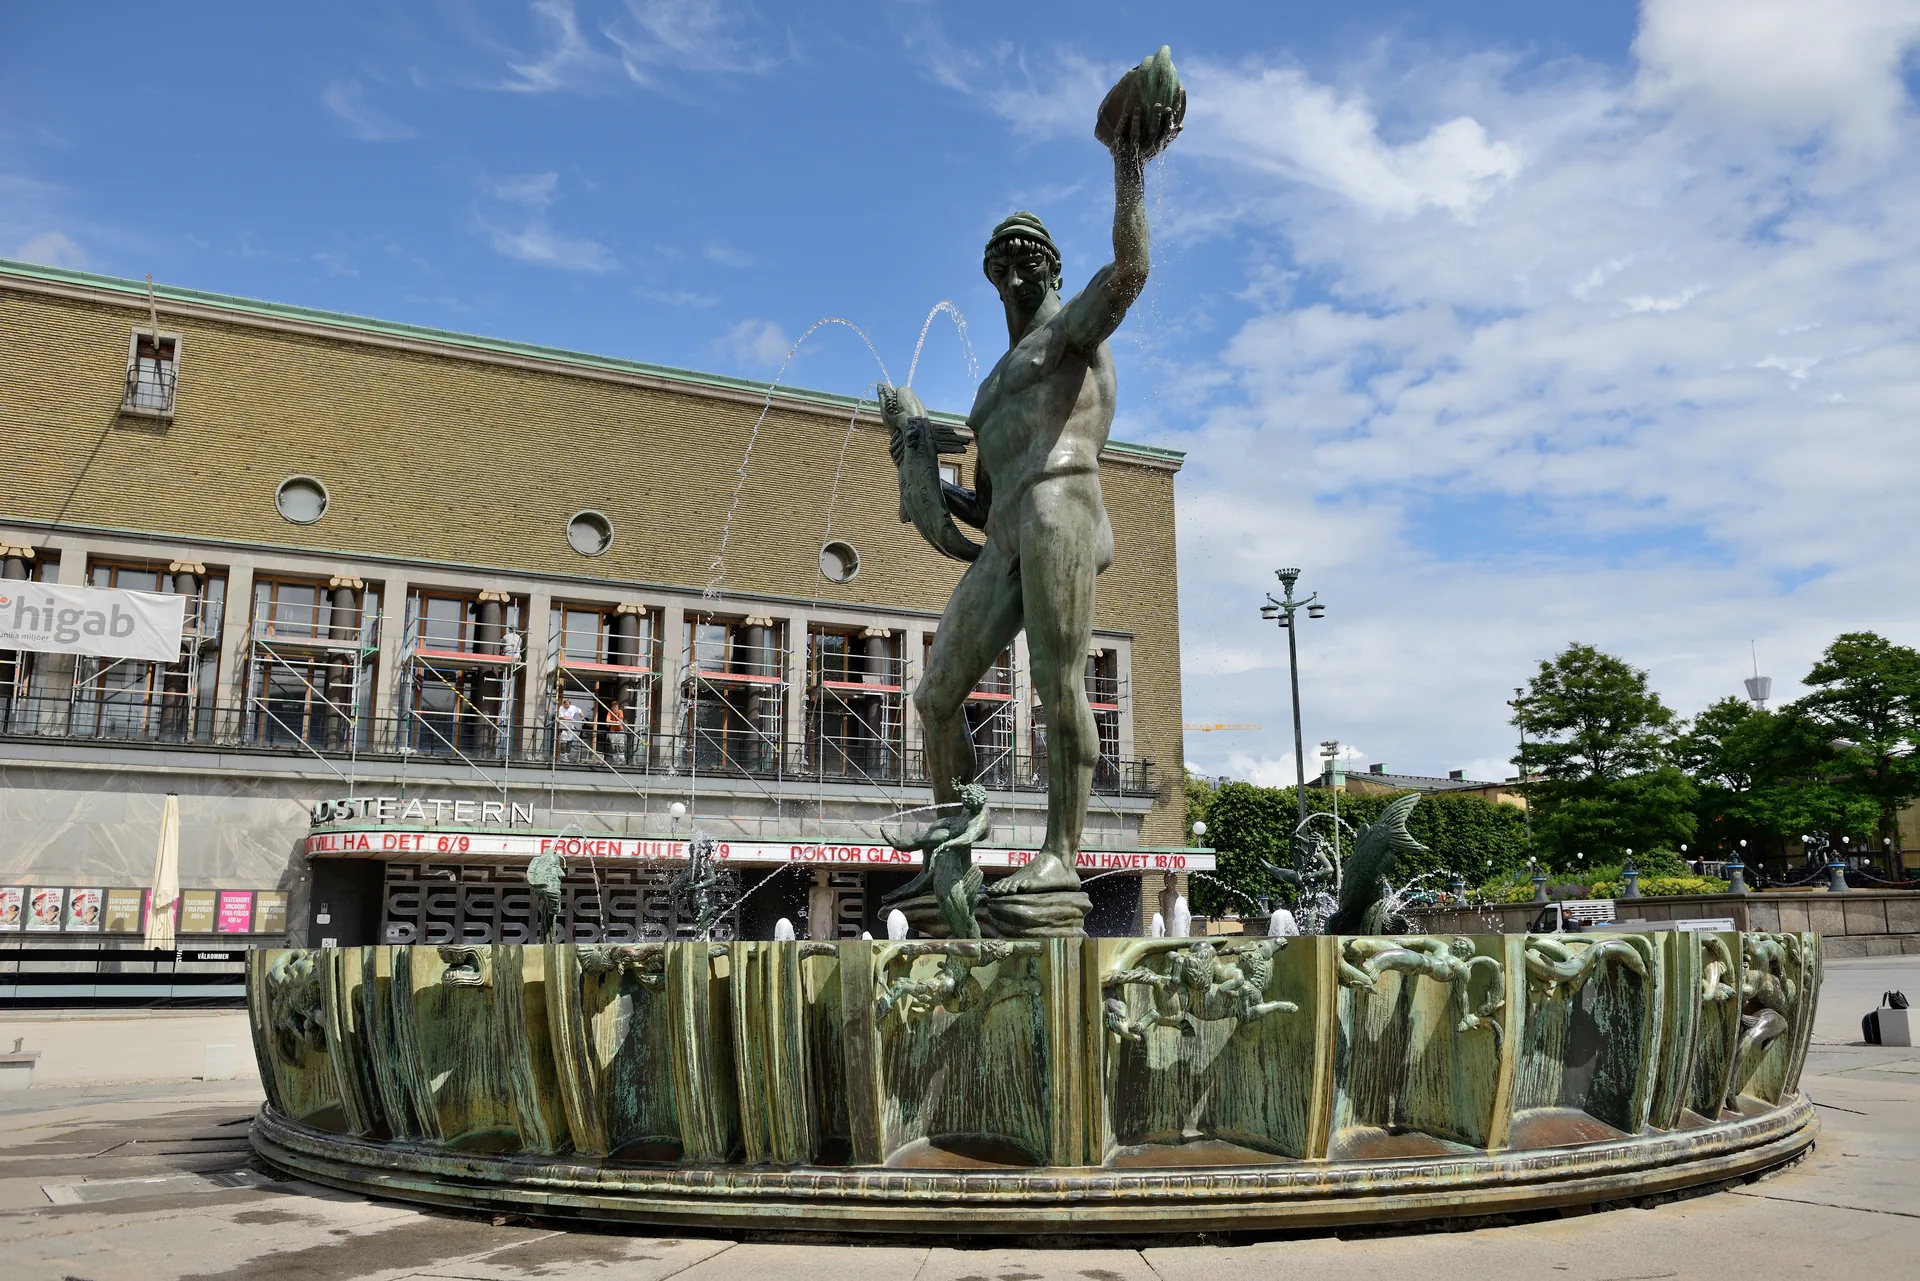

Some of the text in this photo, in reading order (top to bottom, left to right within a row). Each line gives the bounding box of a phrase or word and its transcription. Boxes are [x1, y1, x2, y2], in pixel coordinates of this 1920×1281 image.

[13, 596, 135, 644] higab
[344, 834, 370, 850] HA
[384, 834, 424, 850] DET
[437, 836, 470, 852] 6/9
[541, 837, 622, 857] FRÖKEN
[632, 841, 683, 858] JULIE
[791, 846, 861, 861] DOKTOR
[867, 847, 911, 862] GLAS
[1101, 854, 1149, 869] HAVET
[1155, 855, 1186, 869] 18/10
